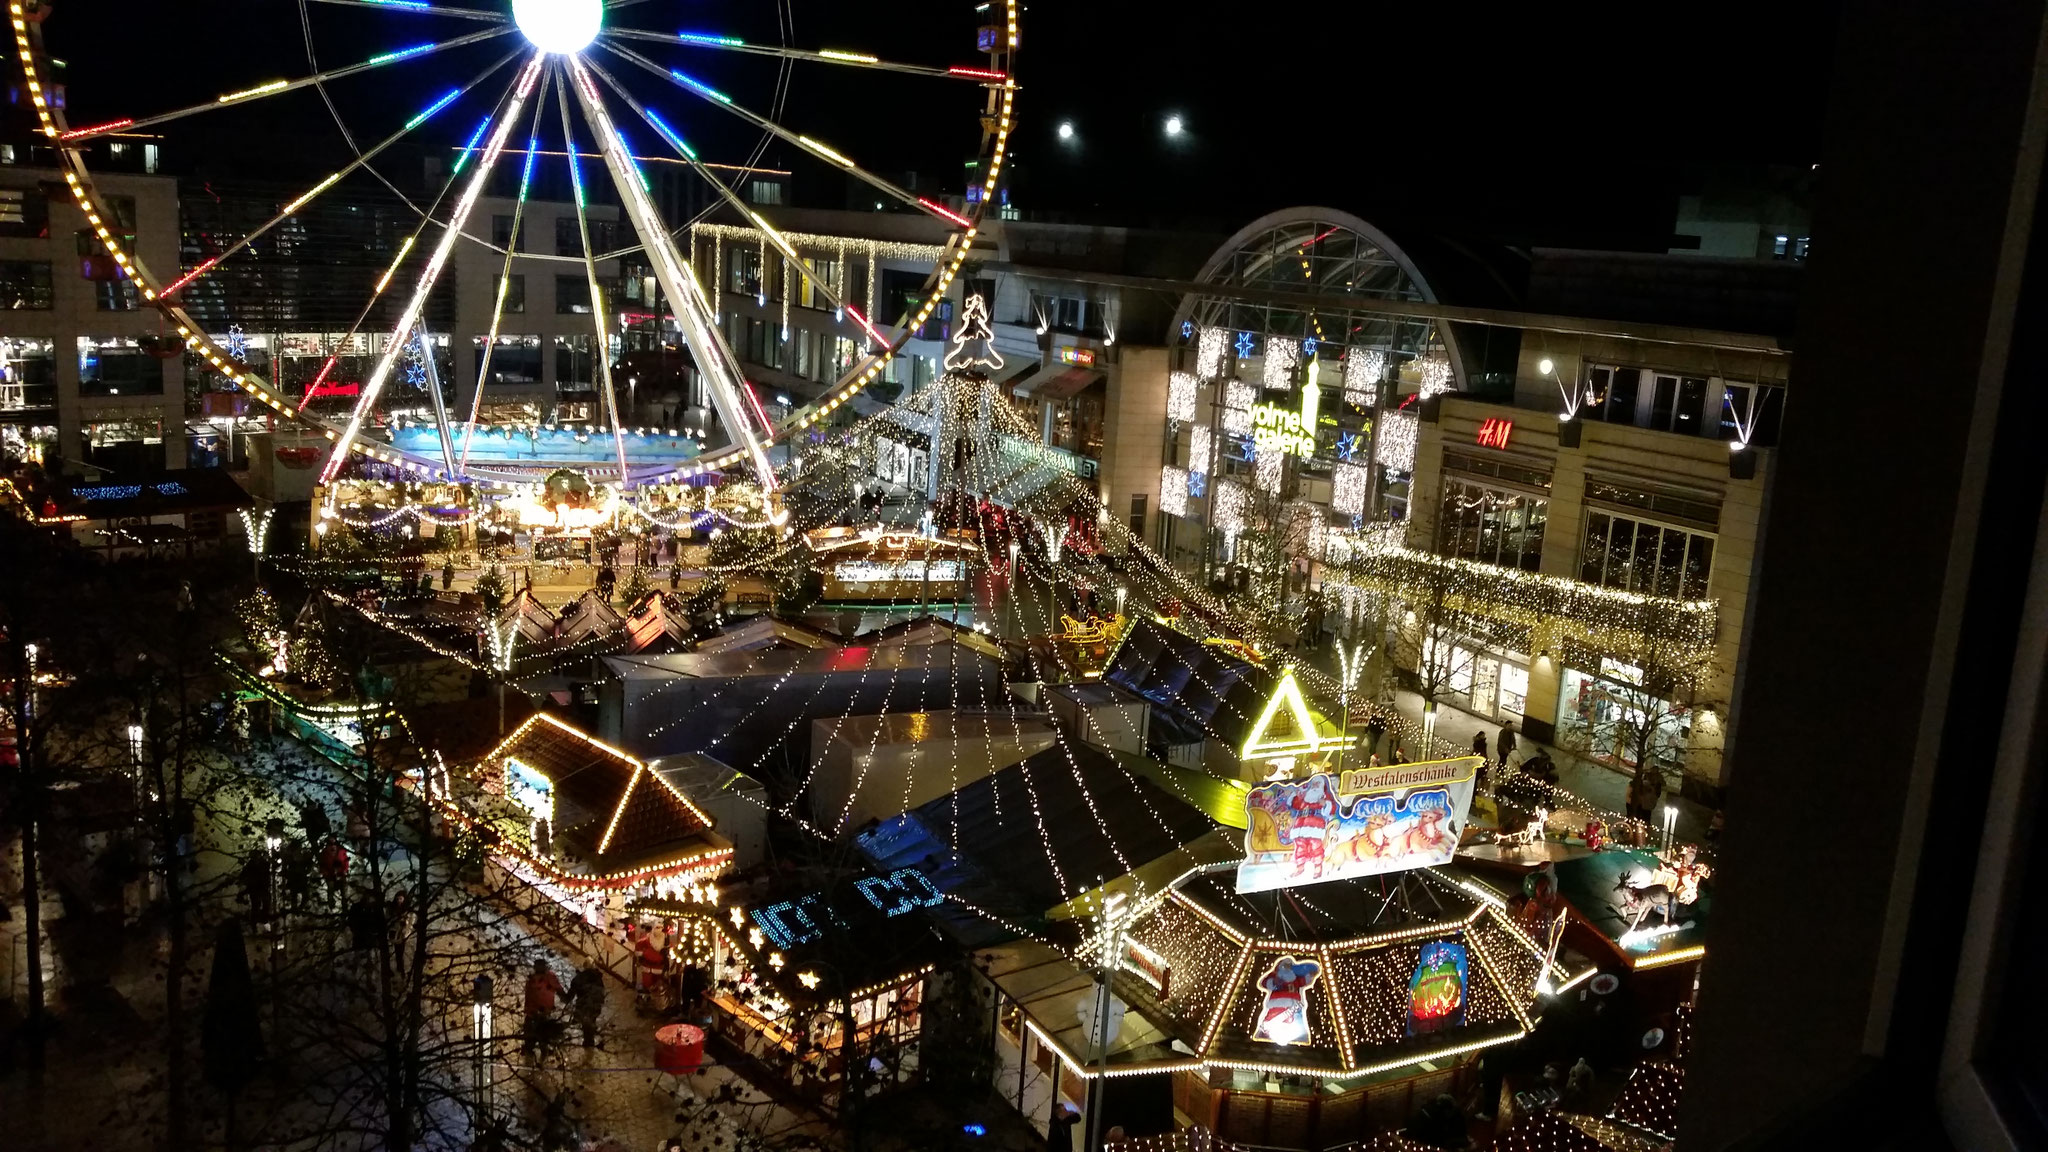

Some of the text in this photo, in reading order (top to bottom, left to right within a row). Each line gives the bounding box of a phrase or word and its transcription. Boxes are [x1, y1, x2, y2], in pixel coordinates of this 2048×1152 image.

[1247, 400, 1301, 433] volme
[1254, 426, 1315, 458] galerie
[1476, 418, 1512, 450] H&M
[1353, 764, 1457, 790] Westfalenschänke
